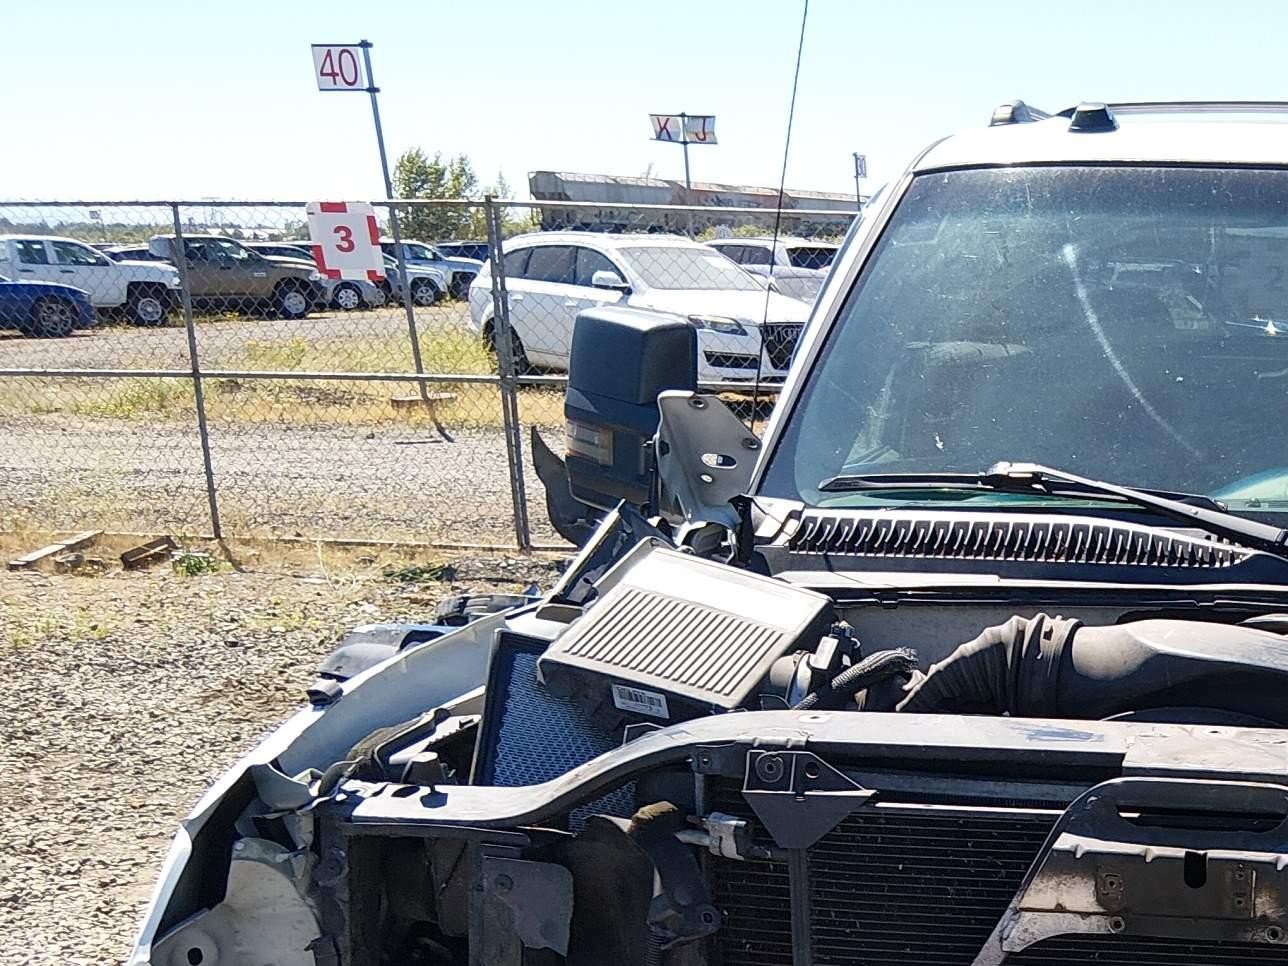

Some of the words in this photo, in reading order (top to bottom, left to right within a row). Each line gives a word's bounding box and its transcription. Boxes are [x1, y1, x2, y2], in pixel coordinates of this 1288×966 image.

[320, 48, 358, 86] 40
[656, 116, 673, 140] K
[695, 117, 707, 141] J
[333, 225, 355, 252] 3
